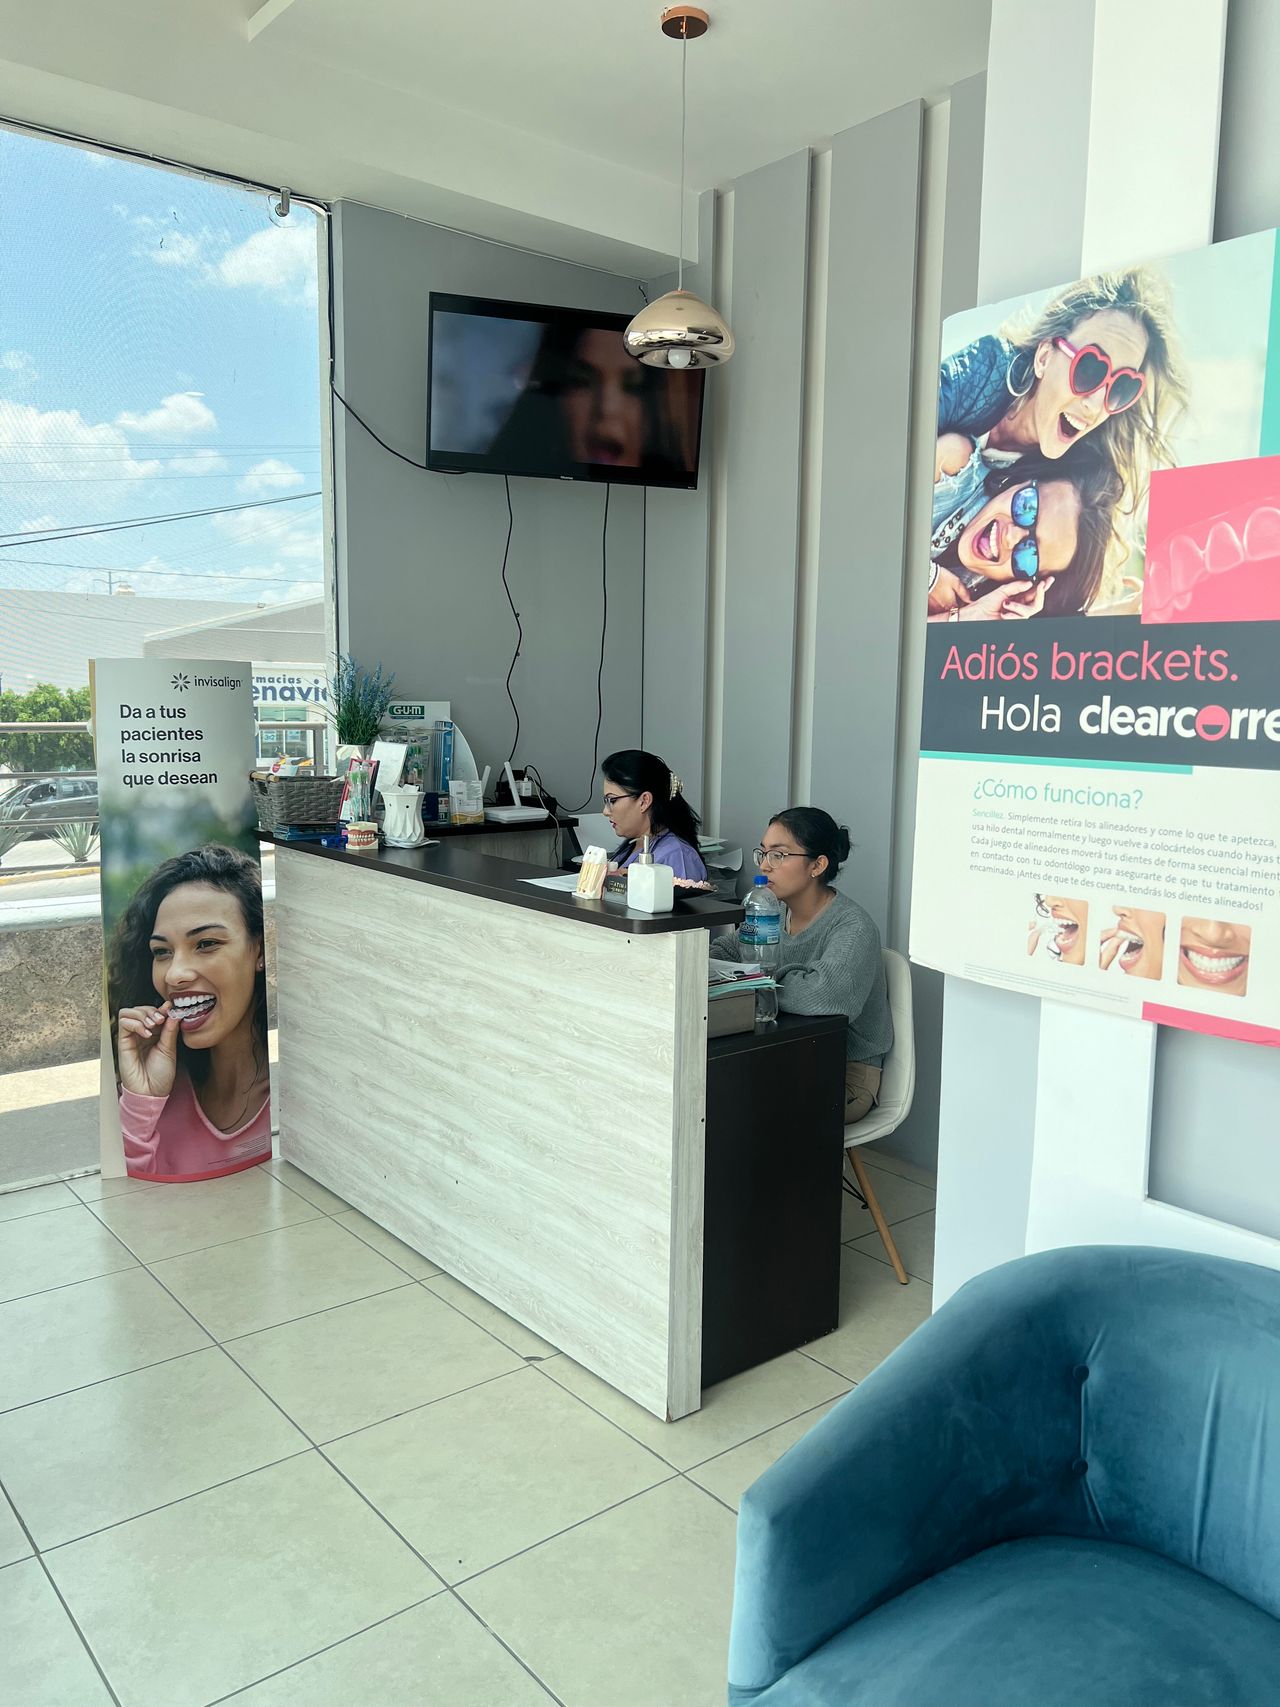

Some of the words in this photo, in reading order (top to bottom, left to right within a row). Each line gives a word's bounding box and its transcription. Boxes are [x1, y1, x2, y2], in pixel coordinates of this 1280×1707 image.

[940, 643, 1039, 681] Adiós
[1051, 640, 1239, 681] brackets.
[194, 675, 241, 690] invisalign
[252, 674, 302, 684] macias
[120, 704, 142, 718] Da
[146, 708, 156, 718] a
[160, 705, 186, 718] tus
[981, 694, 1061, 732] Hola
[1079, 695, 1280, 742] clearcorre
[120, 726, 204, 744] pacientes
[122, 749, 136, 763] la
[139, 748, 201, 763] sonrisa
[122, 774, 154, 788] que
[158, 771, 218, 785] desean
[973, 778, 1038, 801] ¿Cómo
[1043, 782, 1144, 811] funciona?
[986, 824, 1000, 833] hilo
[1001, 825, 1025, 836] dental
[1026, 829, 1081, 842] normalmente
[1088, 835, 1112, 848] luego
[1114, 839, 1142, 849] vuelve
[1207, 850, 1243, 860] cuando
[1245, 851, 1274, 864] hayas
[1008, 812, 1058, 825] Simplemente
[1084, 819, 1096, 829] los
[1098, 821, 1147, 834] alineadores
[1158, 828, 1183, 838] come
[1197, 832, 1215, 842] que
[1231, 834, 1277, 848] apetezca,
[971, 836, 989, 846] Cada
[990, 838, 1011, 850] juego
[1024, 843, 1070, 856] alineadores
[1104, 852, 1118, 861] tus
[1120, 853, 1152, 865] dientes
[1167, 858, 1195, 870] forma
[1198, 864, 1248, 877] secuencial
[969, 864, 1015, 877] encaminado.
[1054, 876, 1069, 885] que
[1080, 878, 1094, 888] des
[1096, 881, 1127, 893] cuenta,
[1129, 884, 1162, 897] tendrás
[1163, 889, 1176, 899] los
[1178, 891, 1212, 904] dientes
[982, 852, 1013, 862] contacto
[1016, 856, 1030, 864] con
[1044, 859, 1090, 874] odontólogo
[1093, 866, 1112, 875] para
[1115, 869, 1162, 882] asegurarte
[1180, 877, 1198, 887] que
[1216, 881, 1275, 897] tratamiento
